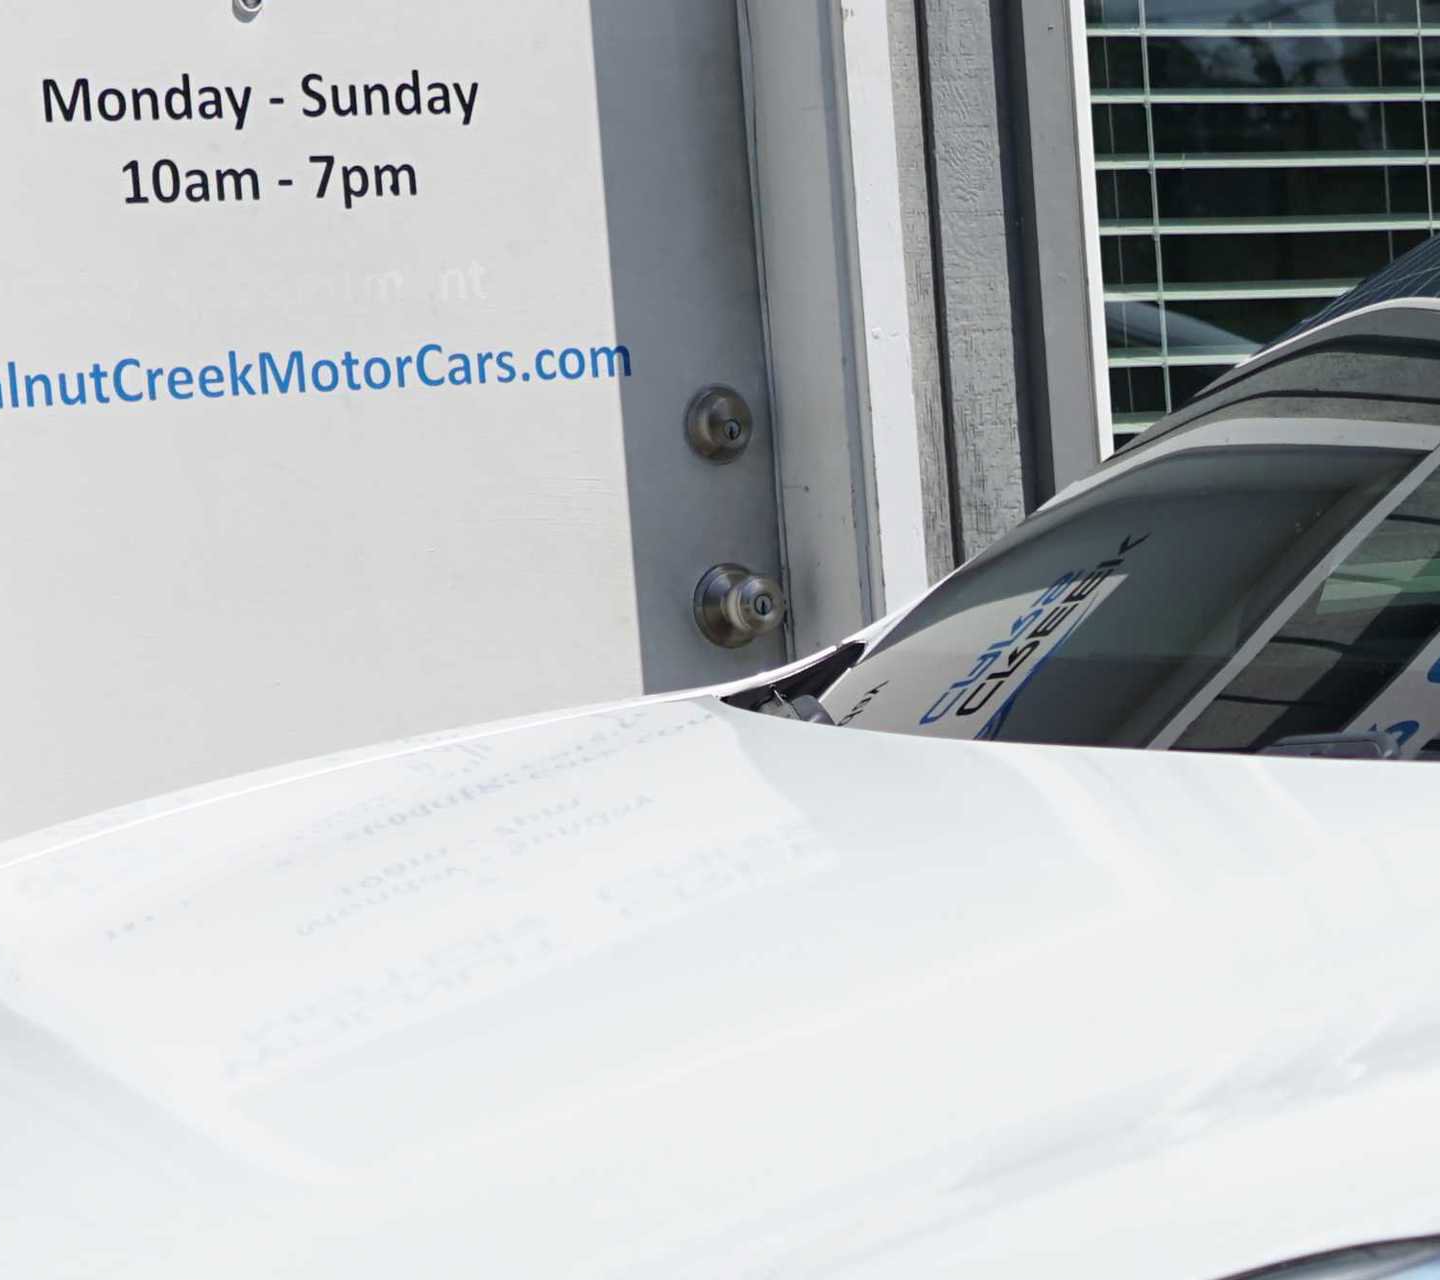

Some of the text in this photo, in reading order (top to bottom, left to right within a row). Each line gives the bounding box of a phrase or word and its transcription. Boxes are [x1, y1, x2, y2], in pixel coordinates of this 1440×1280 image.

[42, 69, 479, 131] Monday - Sunday
[122, 155, 418, 210] 10am - 7pm
